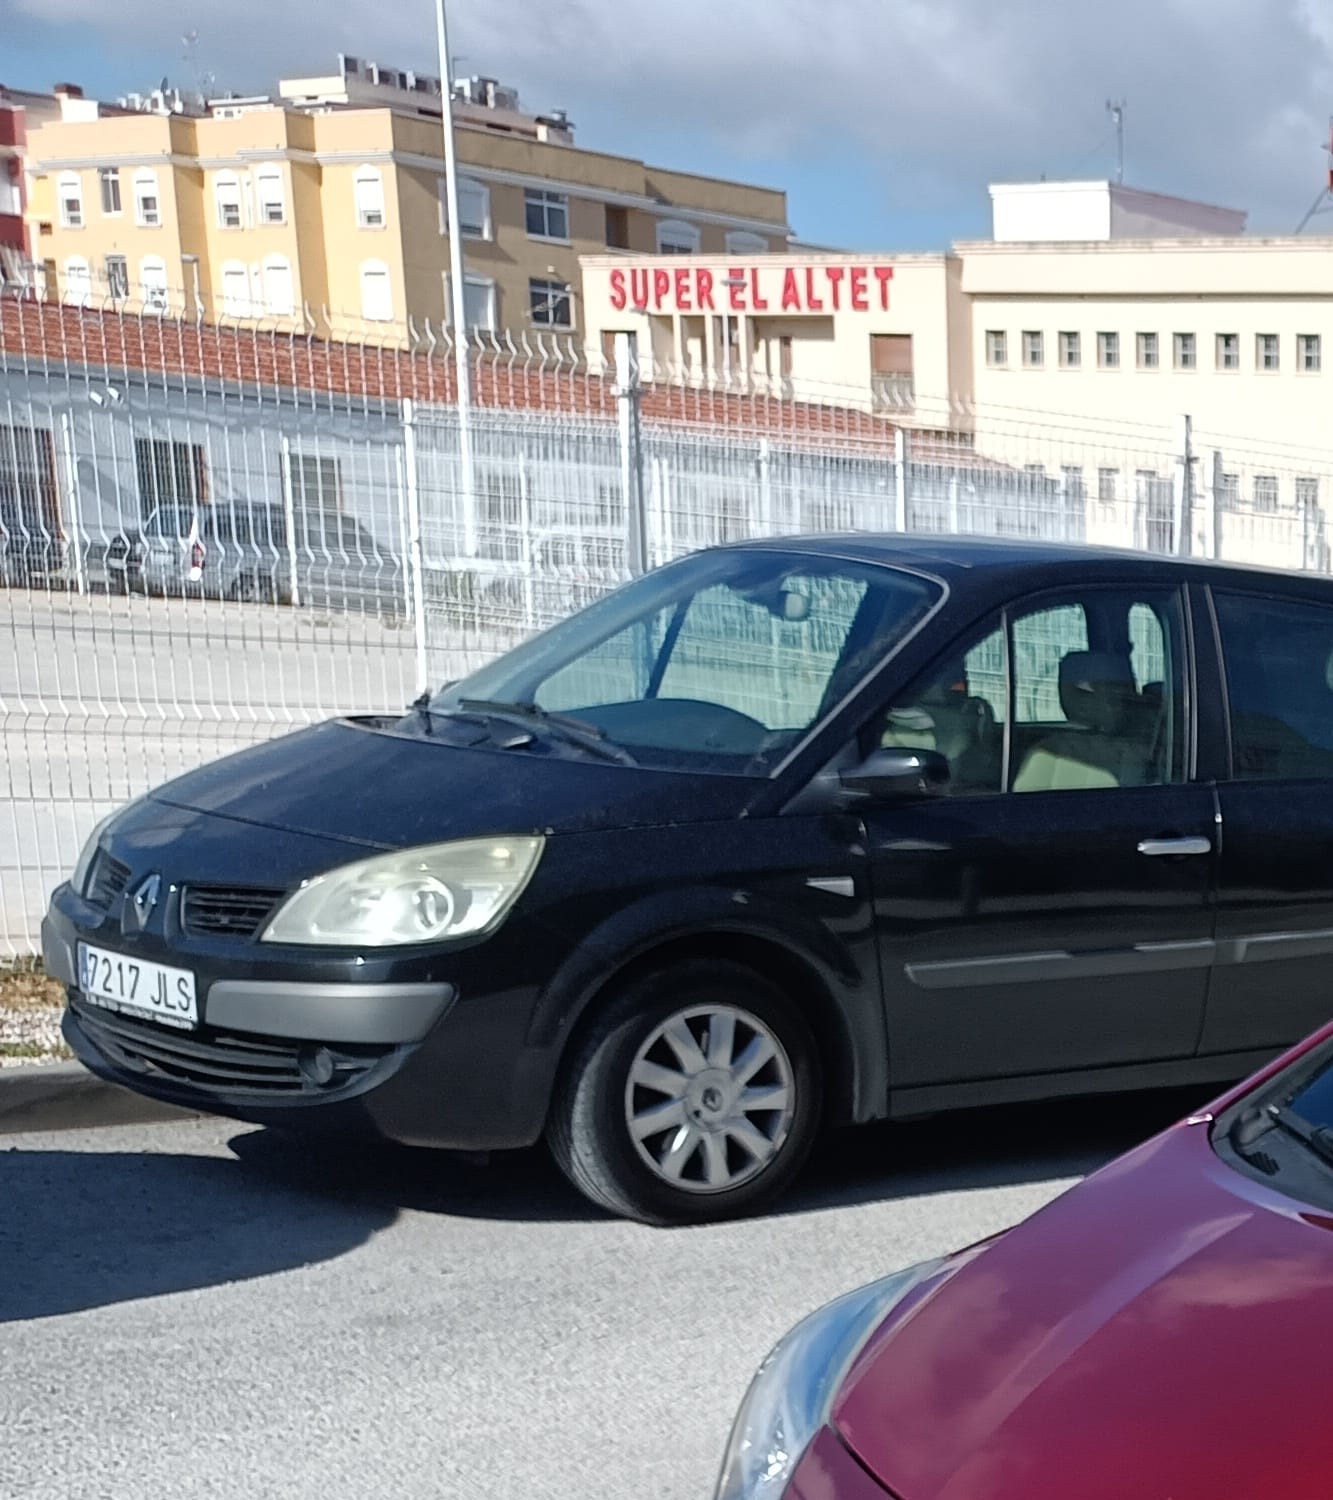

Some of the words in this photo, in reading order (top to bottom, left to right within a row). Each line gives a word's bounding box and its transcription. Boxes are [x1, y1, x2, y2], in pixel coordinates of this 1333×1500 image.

[610, 267, 715, 312] SUPER
[728, 267, 768, 311] EL
[781, 267, 895, 312] ALTET
[88, 953, 140, 1000] 7217
[150, 971, 191, 1012] JLS
